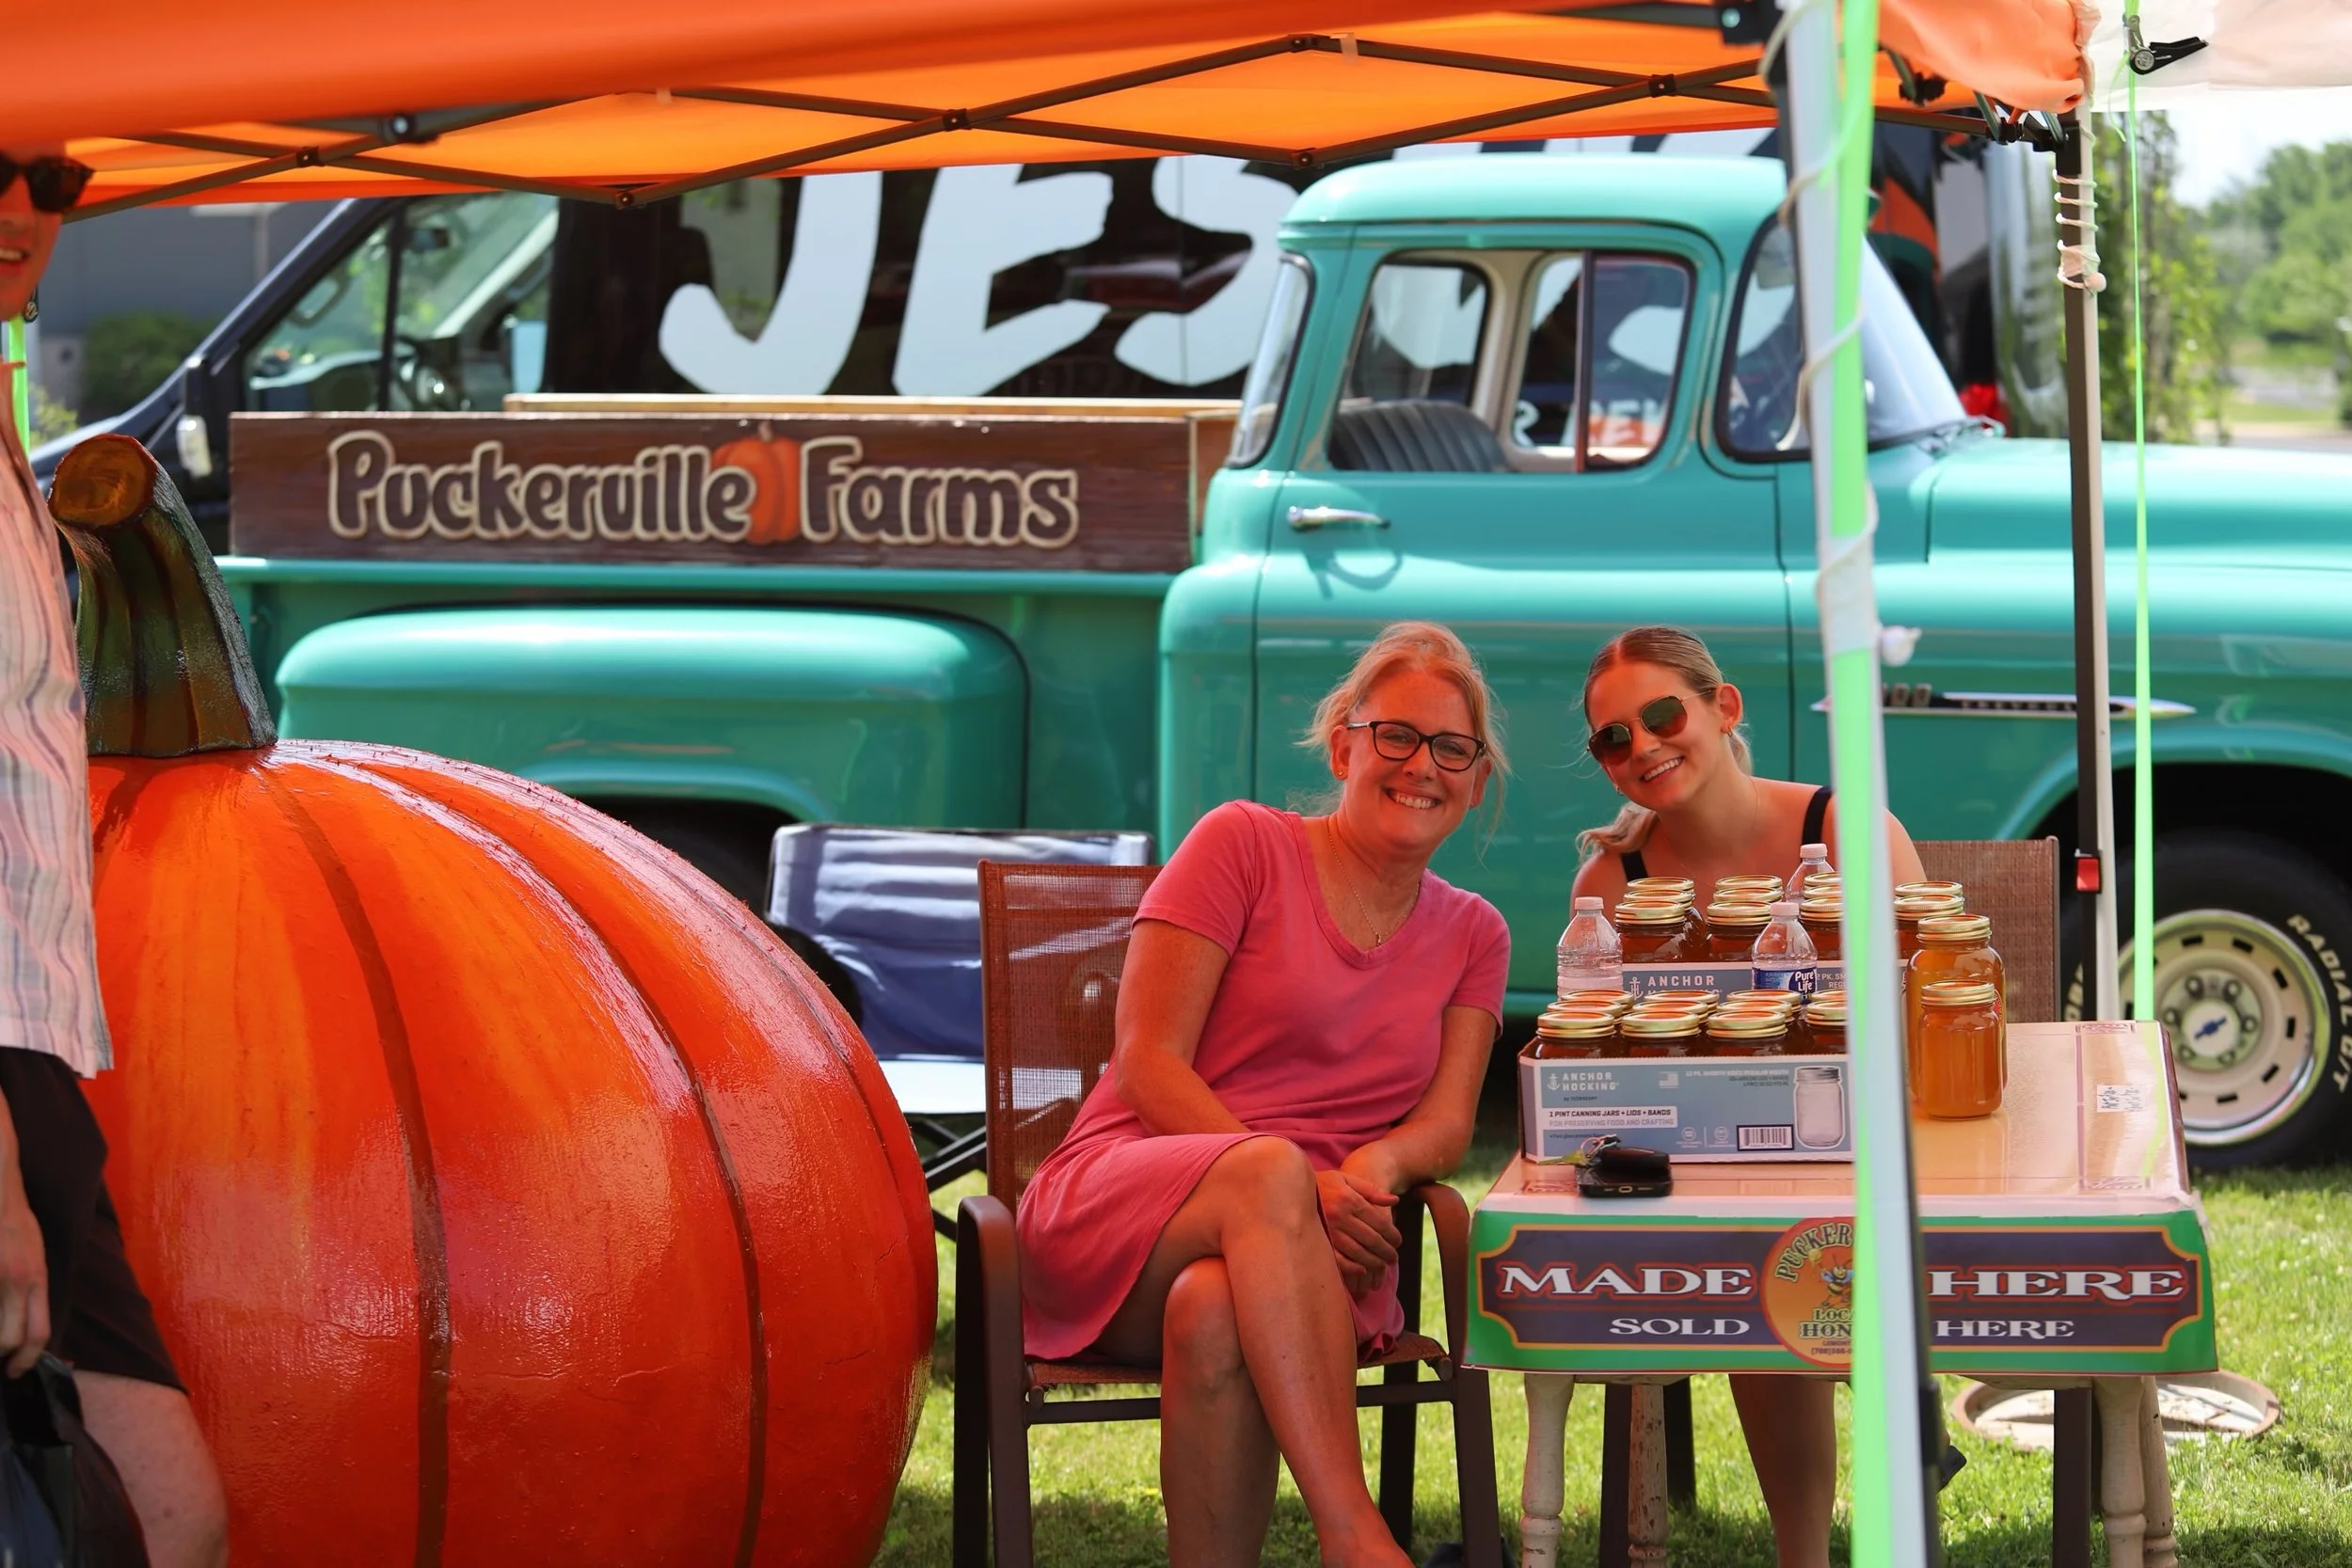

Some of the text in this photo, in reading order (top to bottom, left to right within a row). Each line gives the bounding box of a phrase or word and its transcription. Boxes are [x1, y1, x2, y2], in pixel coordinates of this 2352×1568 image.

[328, 431, 1081, 547] Puckerville Farms
[1794, 971, 1815, 982] Pure
[2286, 913, 2352, 1027] RADIAL
[1647, 974, 1715, 988] ANCHOR
[1798, 979, 1813, 993] Life
[1562, 1071, 1613, 1081] ANCHOR
[1774, 1222, 1853, 1284] PUCKER
[1501, 1265, 2185, 1301] MADE HERE
[1813, 1307, 1854, 1323] LOC
[1608, 1317, 2075, 1340] SOLD HERE
[1800, 1322, 1852, 1339] HON
